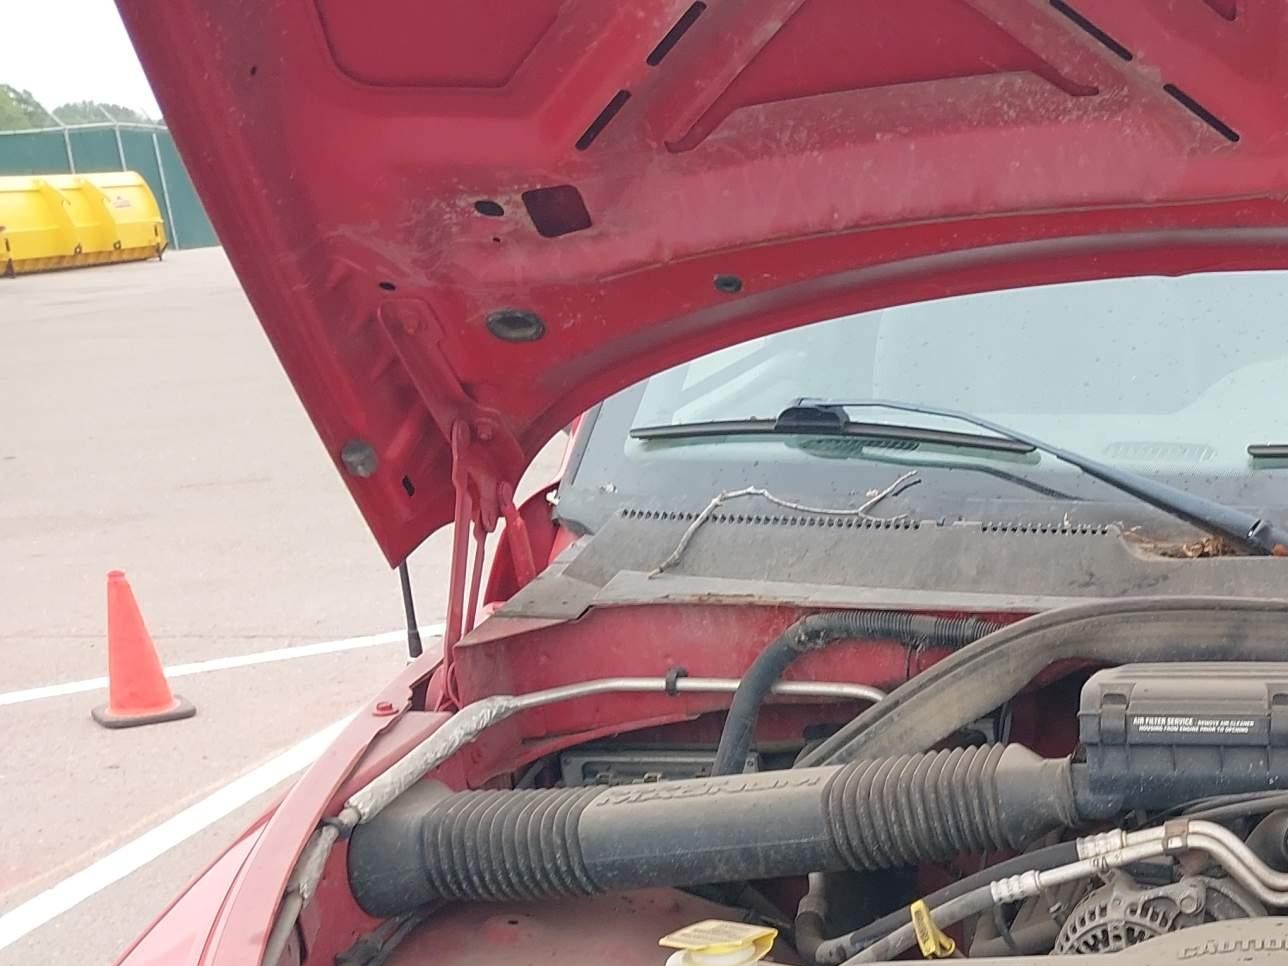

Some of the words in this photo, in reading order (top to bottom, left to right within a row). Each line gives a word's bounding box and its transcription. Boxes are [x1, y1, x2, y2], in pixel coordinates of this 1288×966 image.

[1133, 717, 1145, 726] AIR
[1145, 717, 1166, 726] FILTER
[1167, 717, 1193, 726] SERVICE
